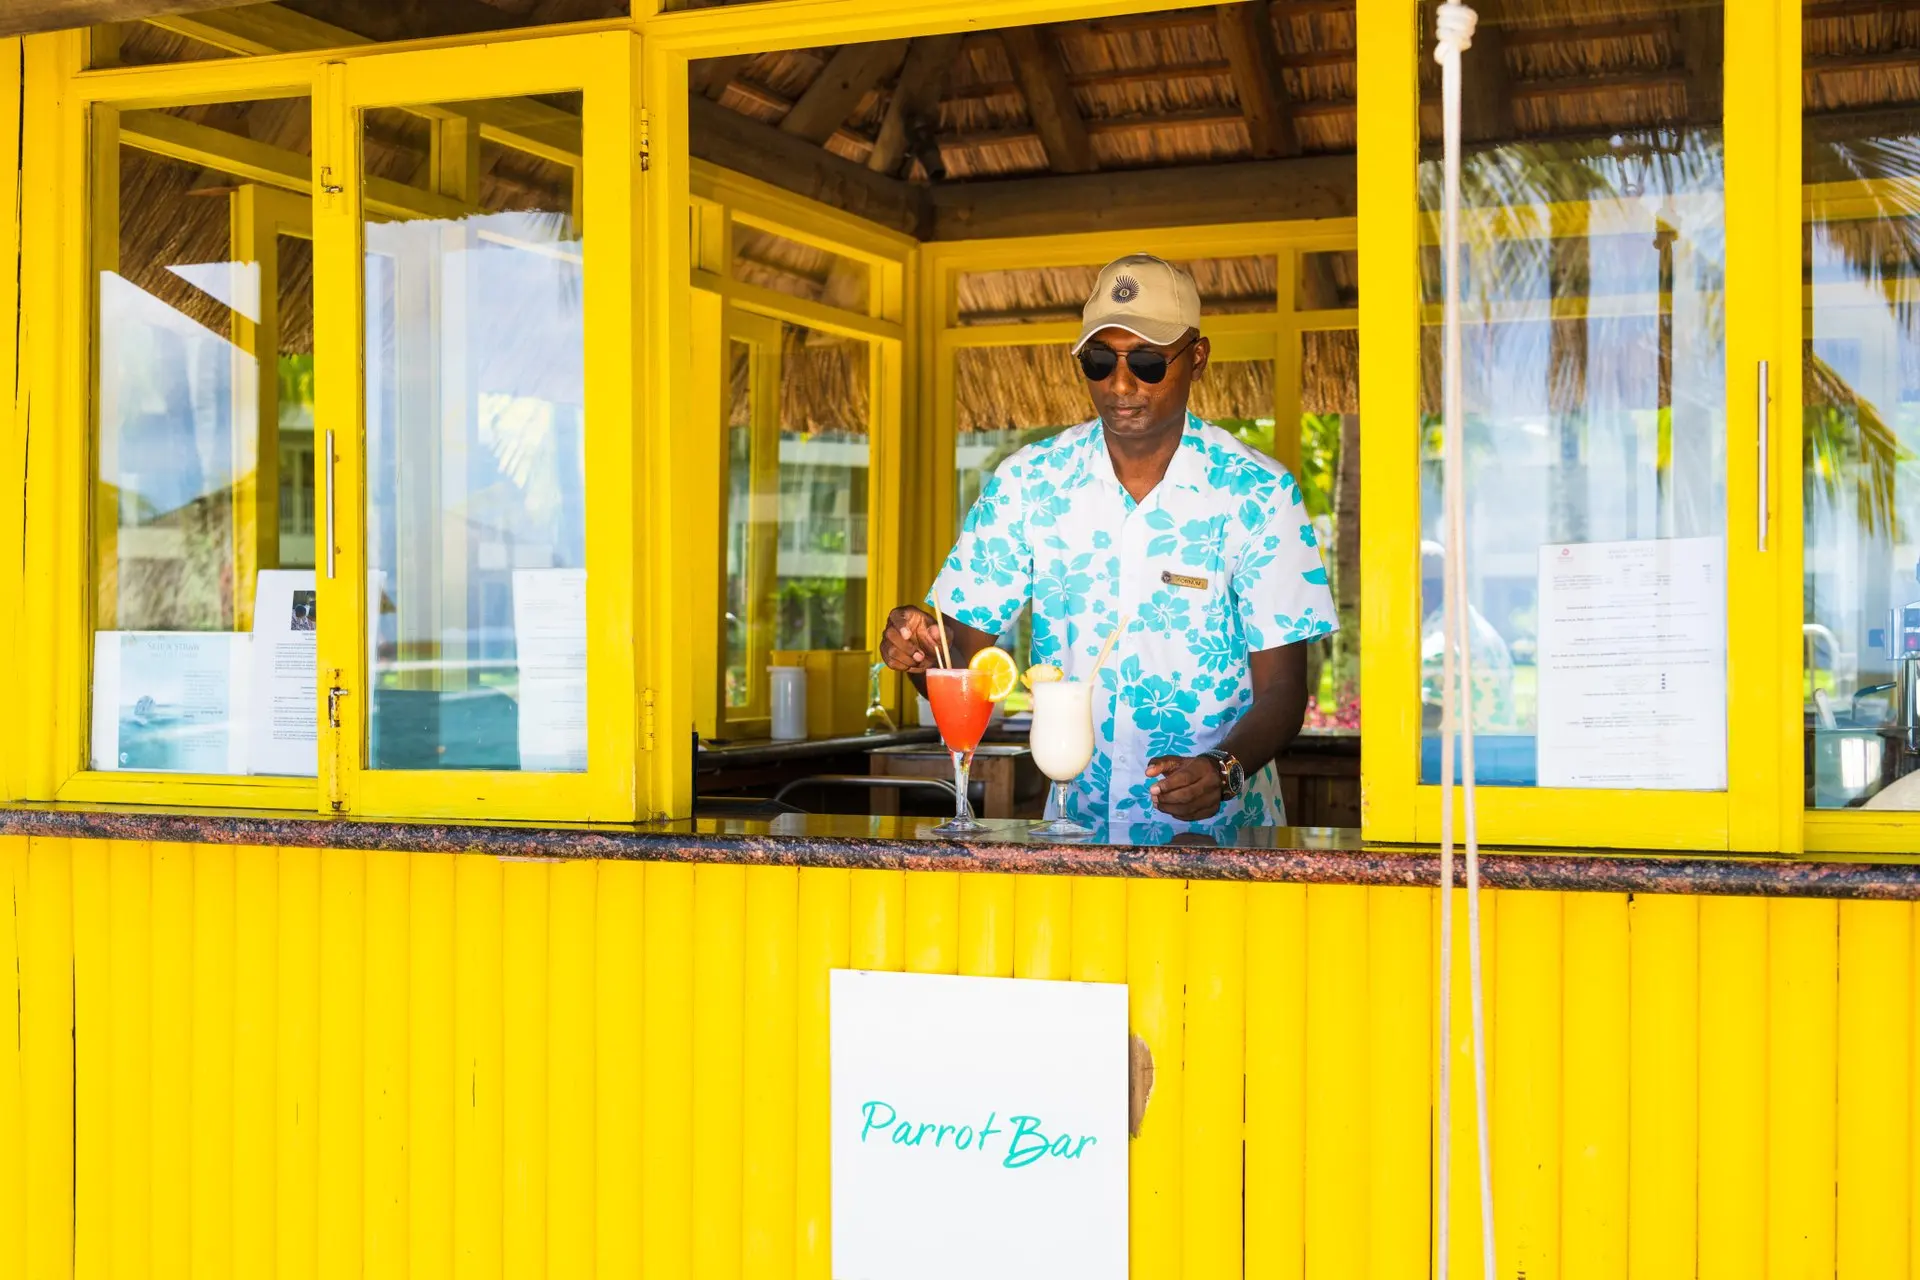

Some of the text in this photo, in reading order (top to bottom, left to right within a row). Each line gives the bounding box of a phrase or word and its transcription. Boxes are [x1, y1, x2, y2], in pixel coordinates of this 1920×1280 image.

[174, 641, 200, 651] STRAW
[861, 1101, 1097, 1168] Parrot Bar
